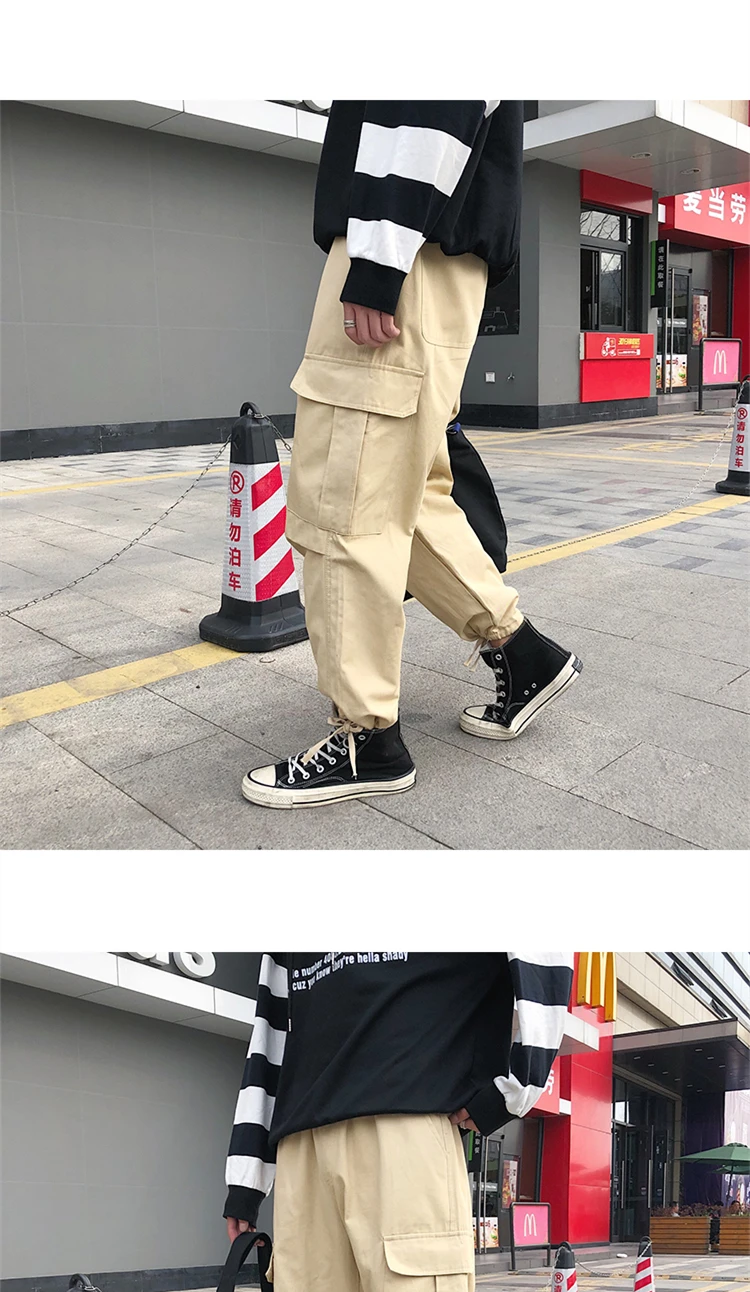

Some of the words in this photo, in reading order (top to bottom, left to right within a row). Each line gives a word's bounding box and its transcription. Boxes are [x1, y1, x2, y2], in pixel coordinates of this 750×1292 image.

[682, 188, 746, 225] 麦当劳
[734, 421, 746, 468] 请勿泊车
[228, 498, 242, 592] 请勿泊车
[292, 980, 306, 991] cuz
[316, 965, 331, 981] know
[357, 952, 380, 964] hella
